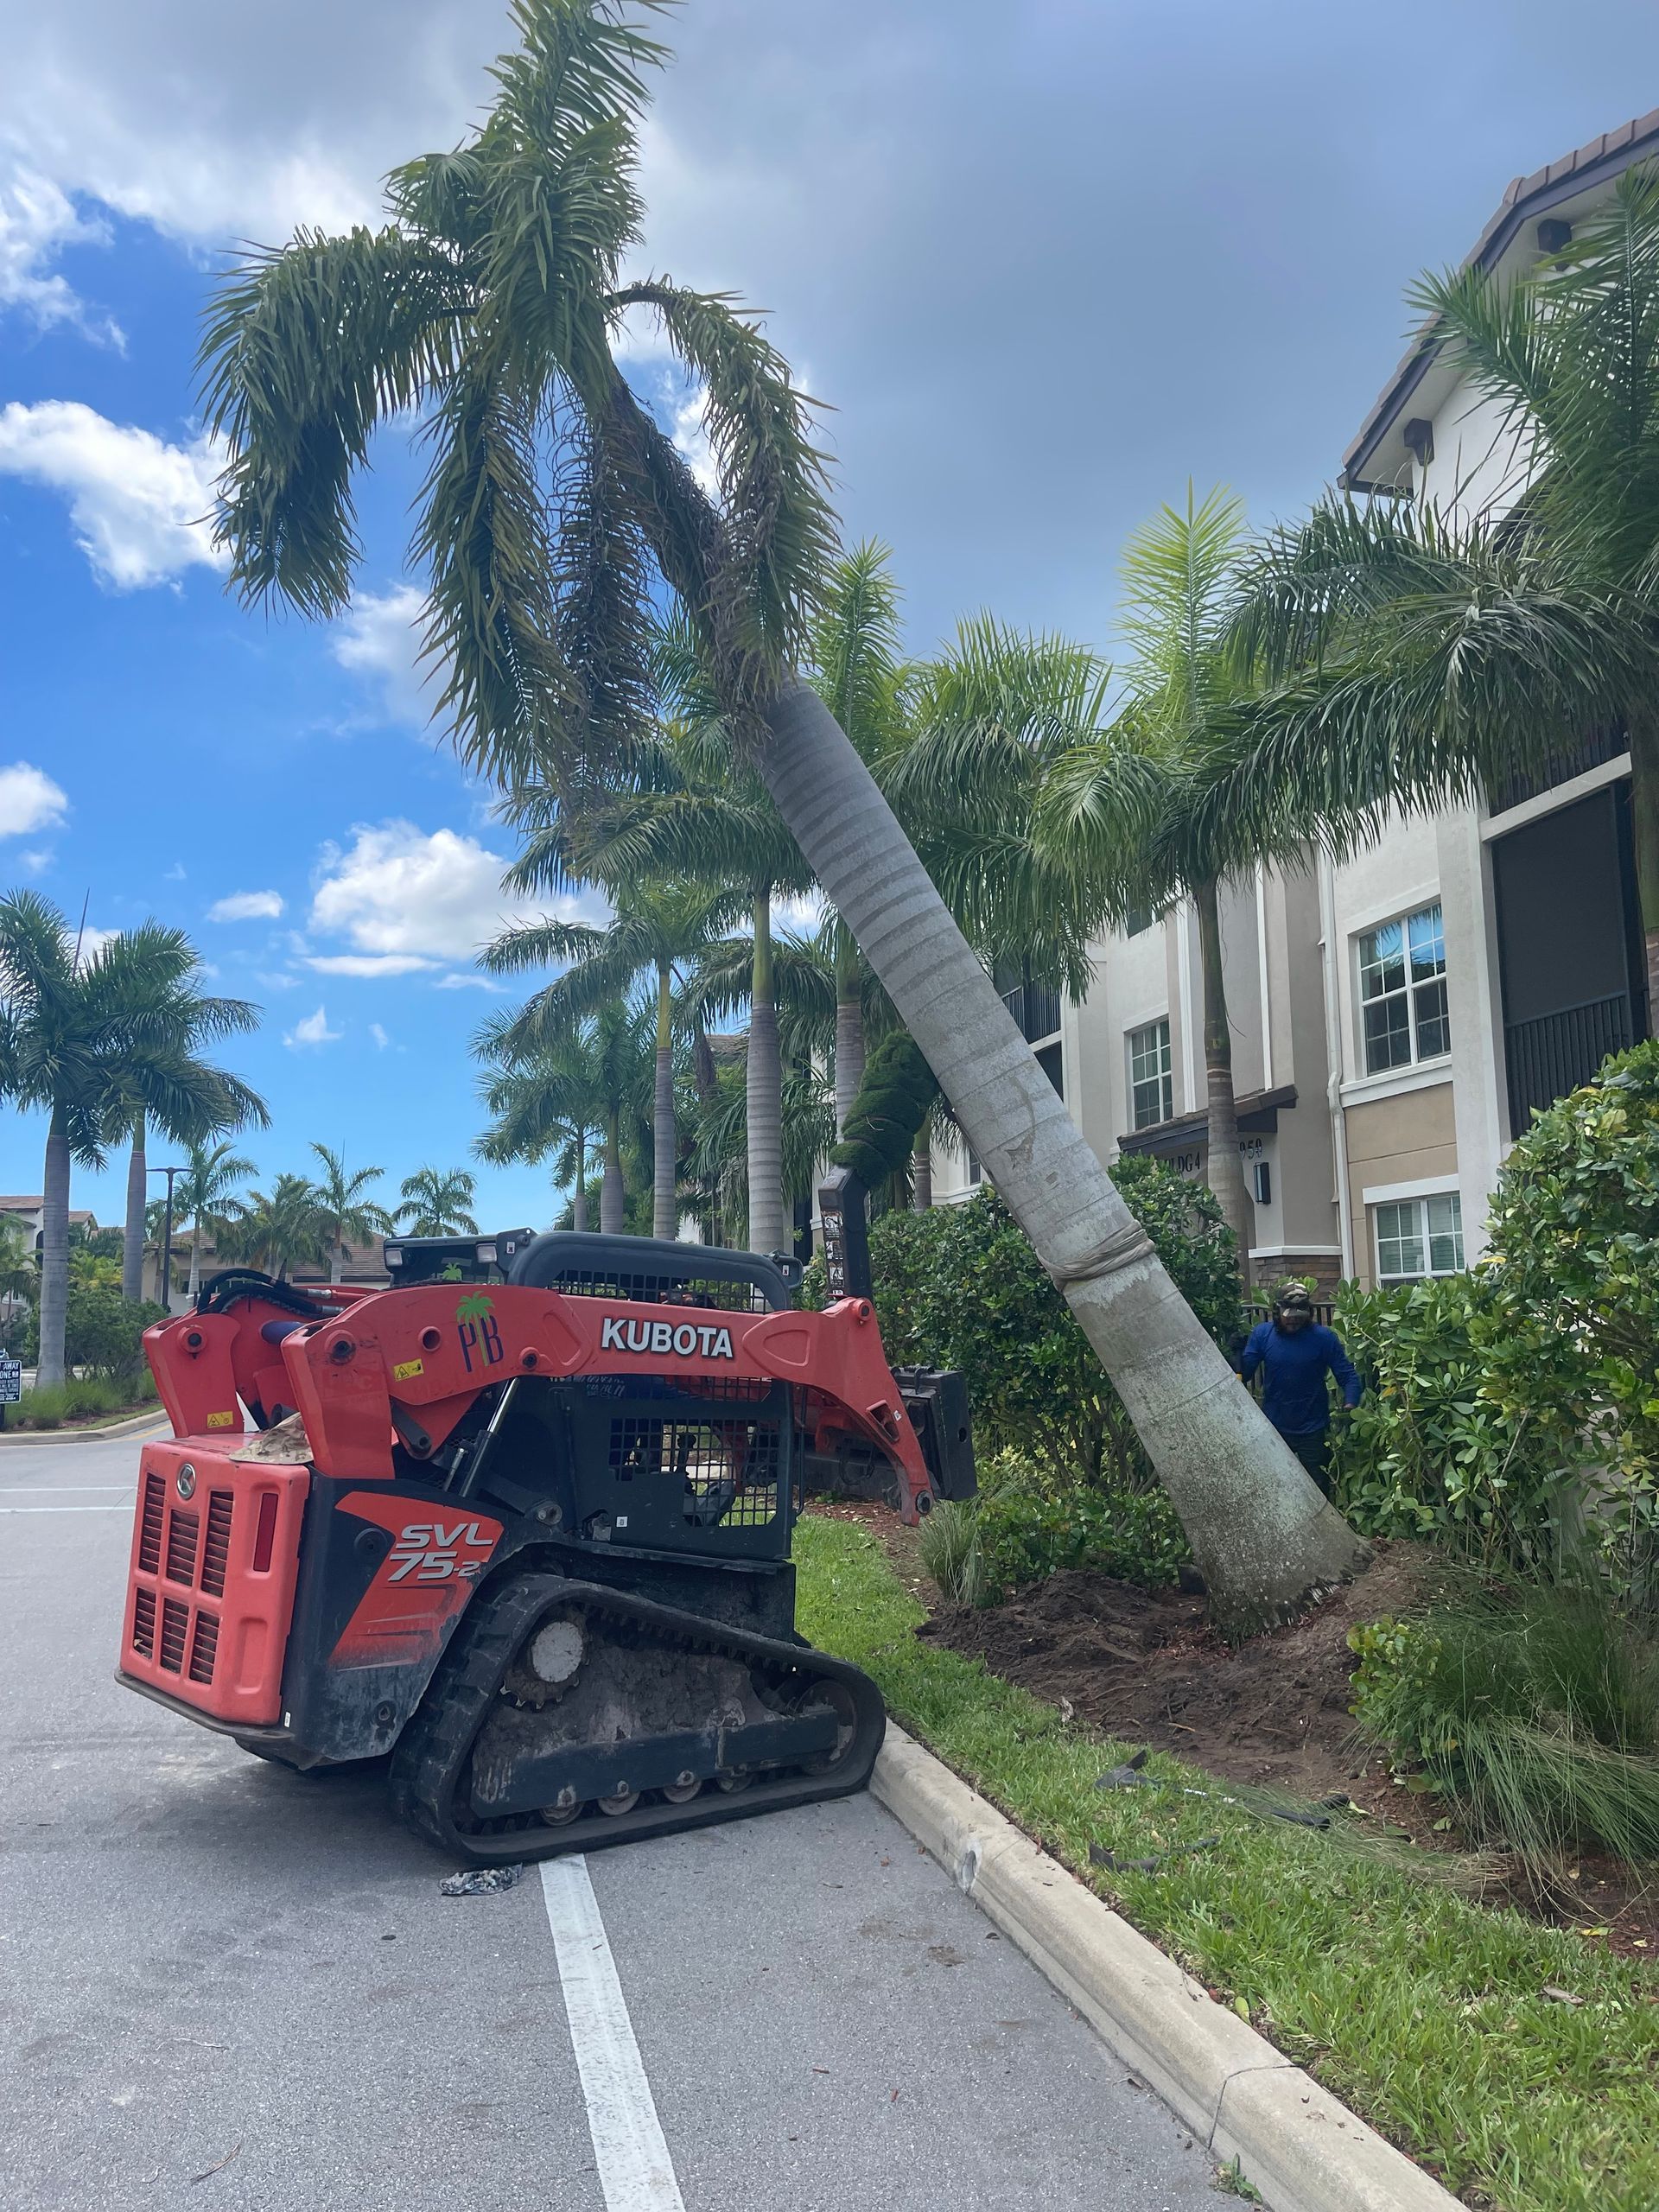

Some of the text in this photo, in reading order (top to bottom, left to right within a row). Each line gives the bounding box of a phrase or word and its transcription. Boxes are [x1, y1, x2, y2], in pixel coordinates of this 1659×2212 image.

[601, 1317, 734, 1358] KUBOTA
[0, 1370, 12, 1379] ONE
[396, 1522, 493, 1549] SVL
[387, 1551, 480, 1581] 75-2
